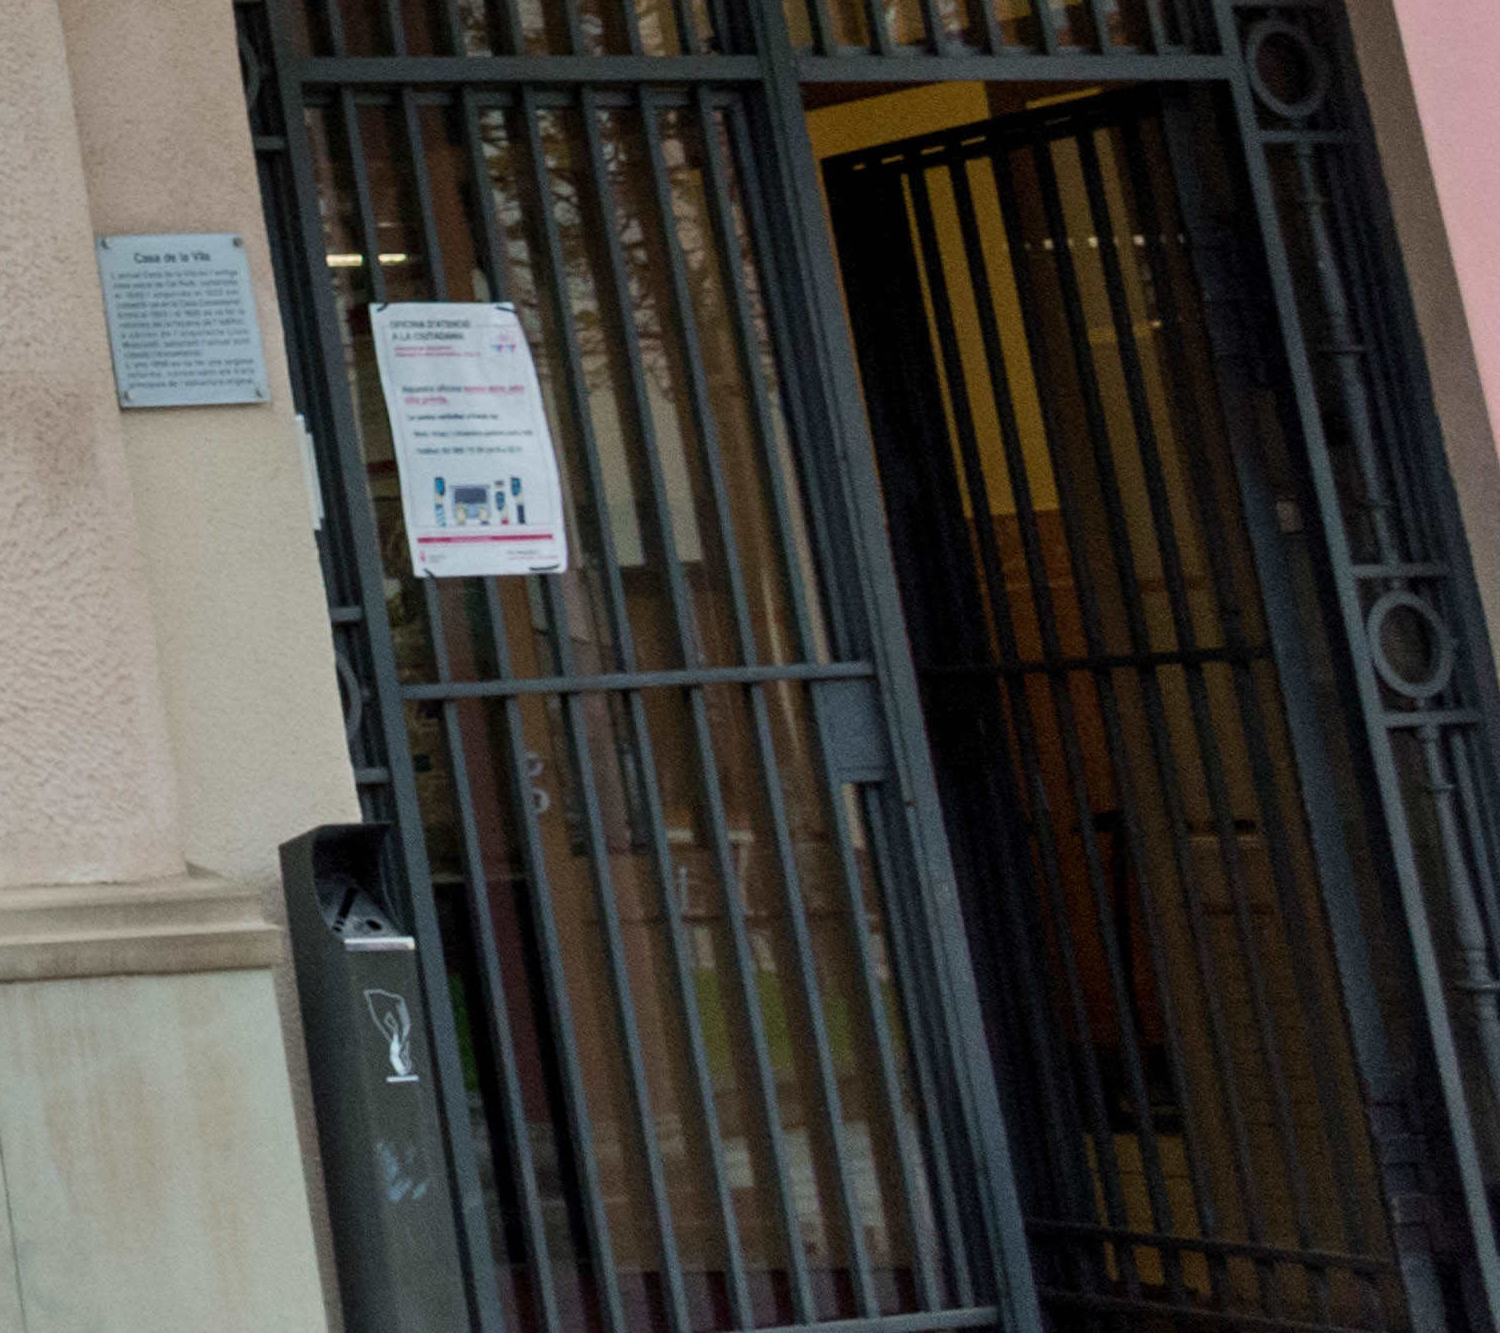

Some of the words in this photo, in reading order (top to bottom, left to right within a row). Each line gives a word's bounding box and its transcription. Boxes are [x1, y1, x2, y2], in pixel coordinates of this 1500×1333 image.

[134, 253, 160, 263] Casa
[164, 252, 176, 262] de
[179, 253, 189, 262] la
[191, 252, 211, 261] Vila
